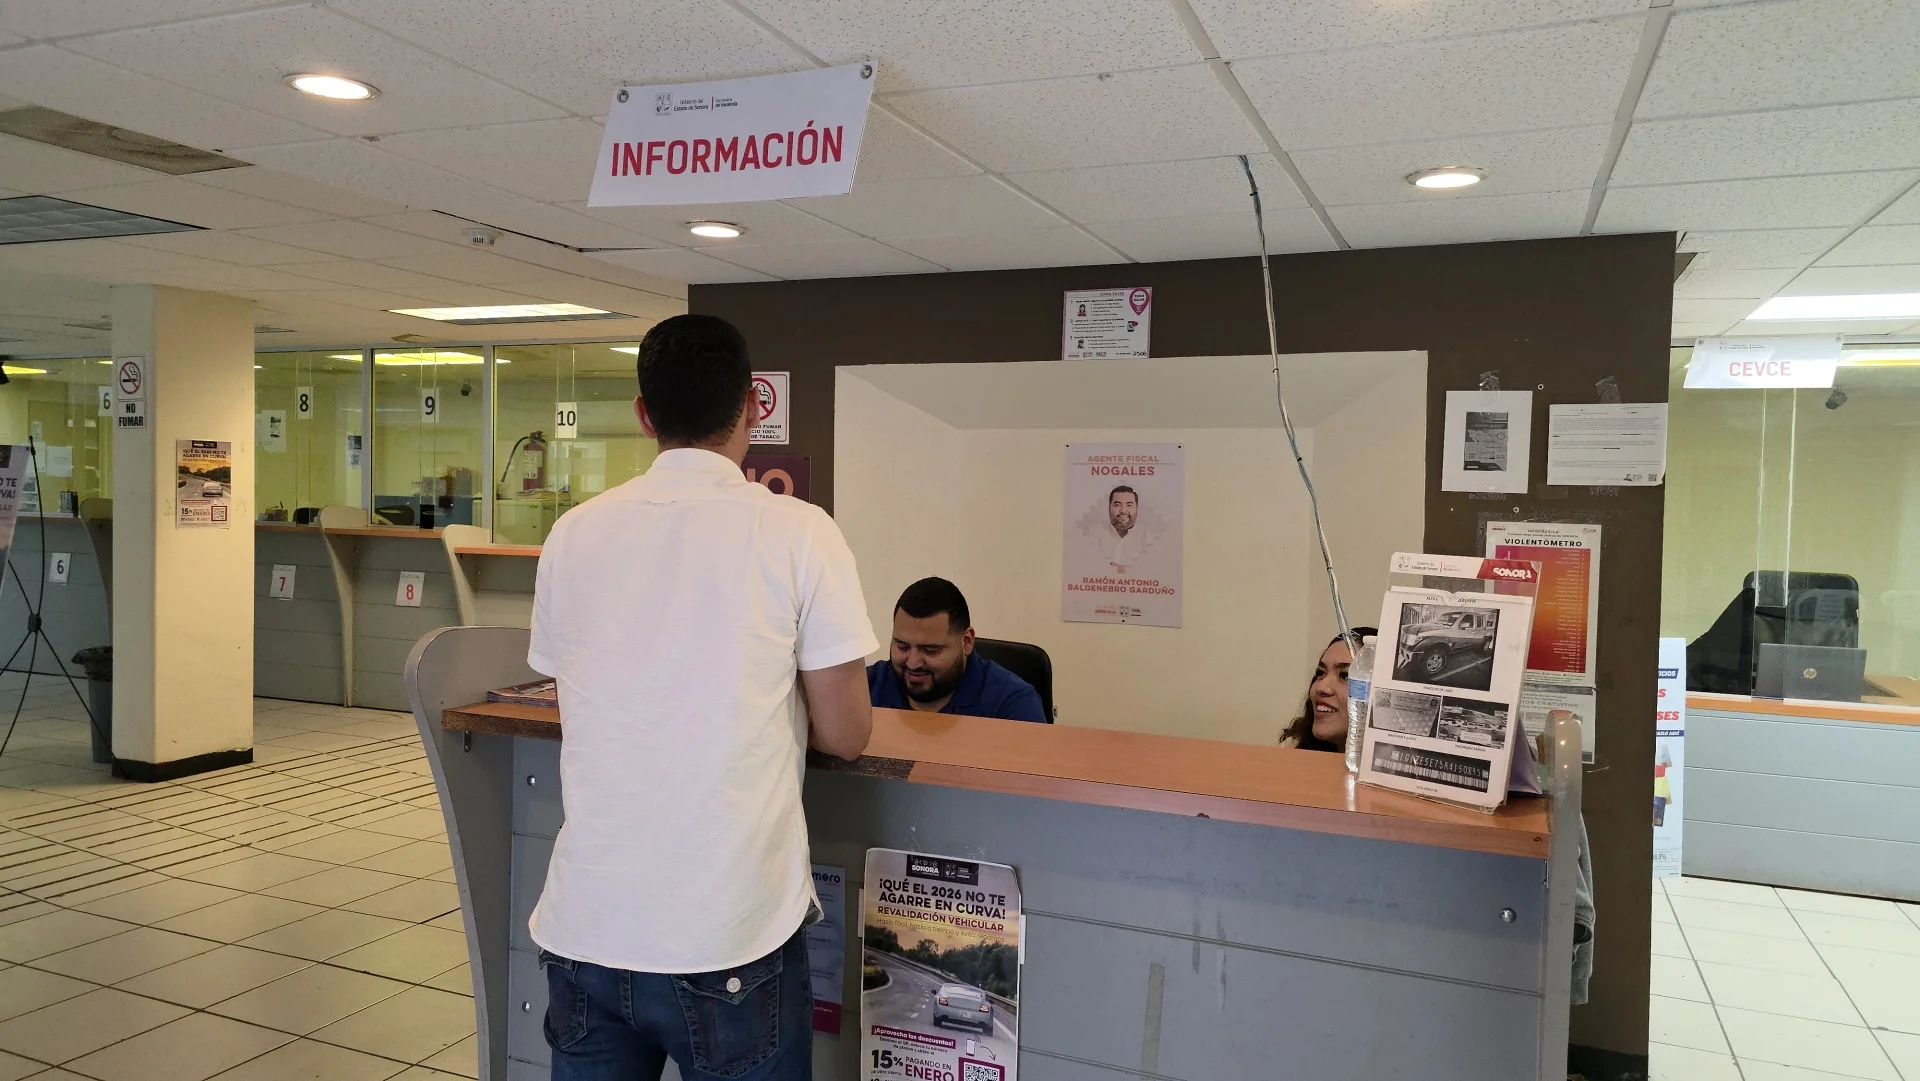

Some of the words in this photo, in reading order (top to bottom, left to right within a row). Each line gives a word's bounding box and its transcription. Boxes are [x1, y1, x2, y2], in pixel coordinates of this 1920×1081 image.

[611, 120, 843, 177] INFORMACIÓN
[1729, 361, 1791, 377] CEVCE
[104, 392, 111, 410] 6
[126, 402, 136, 414] NO
[300, 394, 308, 412] 8
[424, 396, 436, 416] 9
[118, 416, 144, 427] FUMAR
[557, 410, 576, 426] 10
[1088, 455, 1124, 463] AGENTE
[1126, 455, 1160, 463] FISCAL
[1091, 466, 1155, 476] NOGALES
[6, 478, 18, 487] TE
[0, 488, 16, 500] VA!
[1504, 538, 1582, 547] VIOLENTÓMETRO
[57, 560, 64, 574] 6
[1493, 567, 1532, 578] SONORA
[279, 576, 286, 592] 7
[1067, 584, 1127, 593] BALDENEBRO
[1130, 586, 1175, 595] GARDUÑO
[1082, 576, 1116, 585] RAMÓN
[1118, 578, 1160, 587] ANTONIO
[406, 584, 414, 600] 8
[1658, 688, 1666, 698] S
[1656, 711, 1680, 720] SES
[912, 864, 940, 874] SONORA
[879, 878, 910, 892] ¡QUÉ
[913, 882, 928, 896] EL
[931, 886, 962, 900] 2026
[966, 890, 986, 904] NO
[989, 893, 1006, 906] TE
[878, 891, 932, 909] AGARRE
[935, 898, 952, 912] EN
[956, 902, 1006, 920] CURVA!
[878, 906, 946, 924] REVALIDACIÓN
[948, 916, 1004, 932] VEHICULAR
[876, 918, 894, 926] Hazlo
[910, 922, 927, 931] hazlo
[932, 926, 955, 936] tiempo
[960, 930, 976, 939] evita
[874, 1027, 908, 1040] ¡Aprovecha
[908, 1032, 918, 1040] los
[917, 1034, 954, 1048] descuentos!
[872, 1049, 904, 1069] 15%
[905, 1056, 940, 1069] PAGANDO
[942, 1063, 952, 1071] EN
[905, 1064, 955, 1081] ENERO
